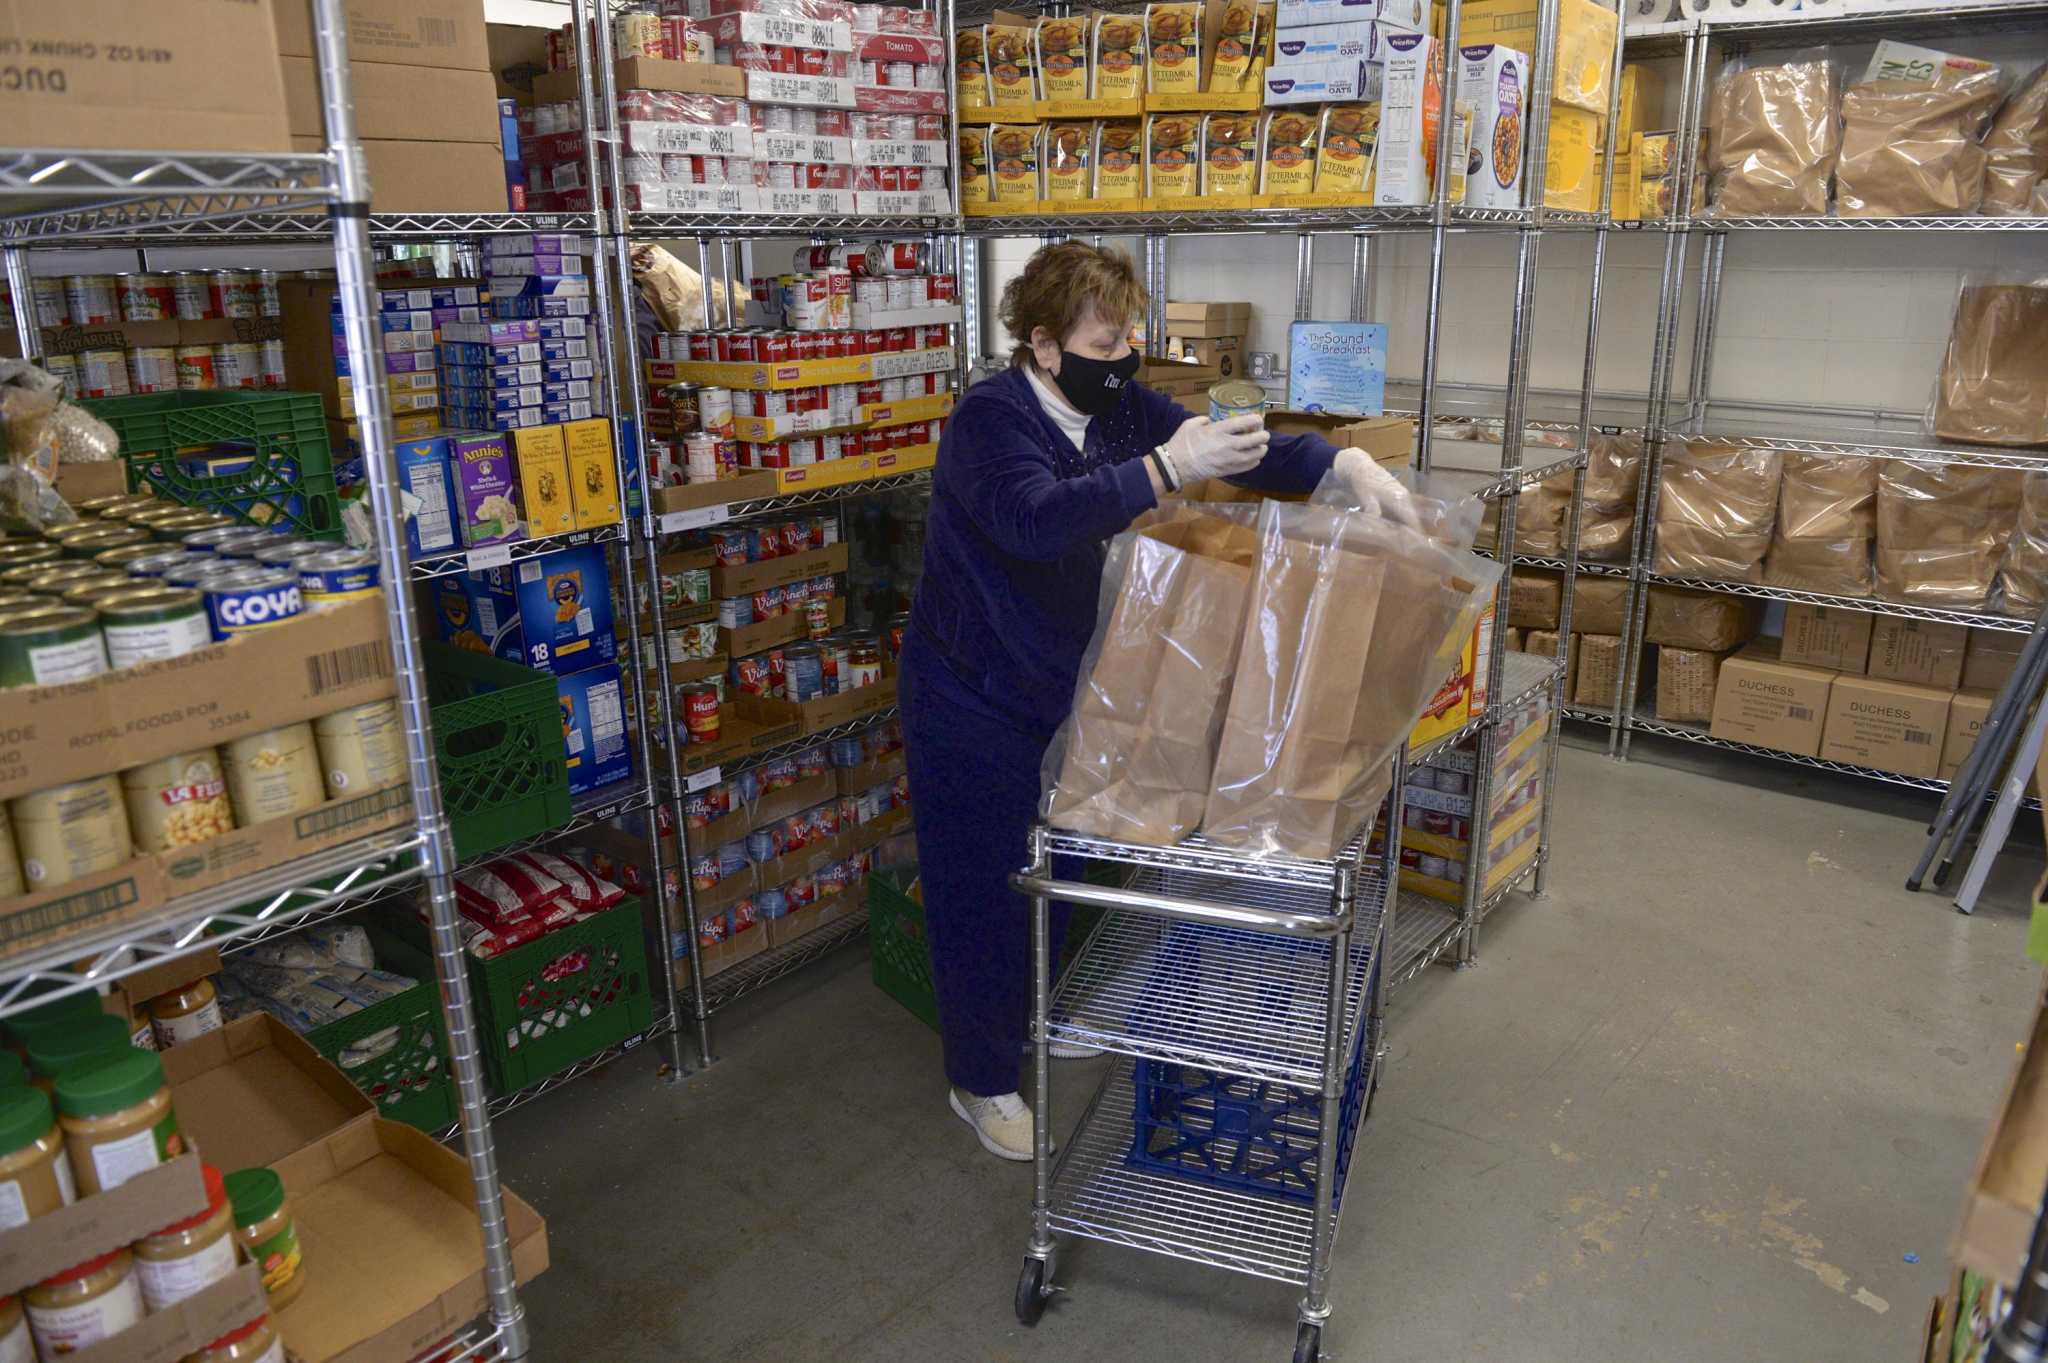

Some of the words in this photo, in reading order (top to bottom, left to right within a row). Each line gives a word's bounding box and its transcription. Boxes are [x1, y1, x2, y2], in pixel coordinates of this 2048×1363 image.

[886, 41, 913, 52] TOMATO
[1499, 90, 1518, 103] OATS
[555, 140, 585, 153] TOMAT
[535, 216, 558, 225] ULINE
[1310, 333, 1325, 342] The
[1324, 332, 1364, 344] Sound
[1322, 342, 1371, 354] Breakfast
[1104, 373, 1121, 389] I'm
[463, 446, 504, 461] Annie's
[568, 533, 590, 543] ULINE
[220, 586, 304, 625] GOYA
[531, 642, 549, 662] 18
[166, 648, 226, 671] BEANS
[1738, 679, 1795, 697] DUCHESS
[1850, 701, 1911, 720] DUCHESS
[69, 726, 124, 749] ROYAL
[126, 709, 184, 733] FOODS
[596, 806, 616, 818] ULINE
[624, 1034, 643, 1048] ULINE
